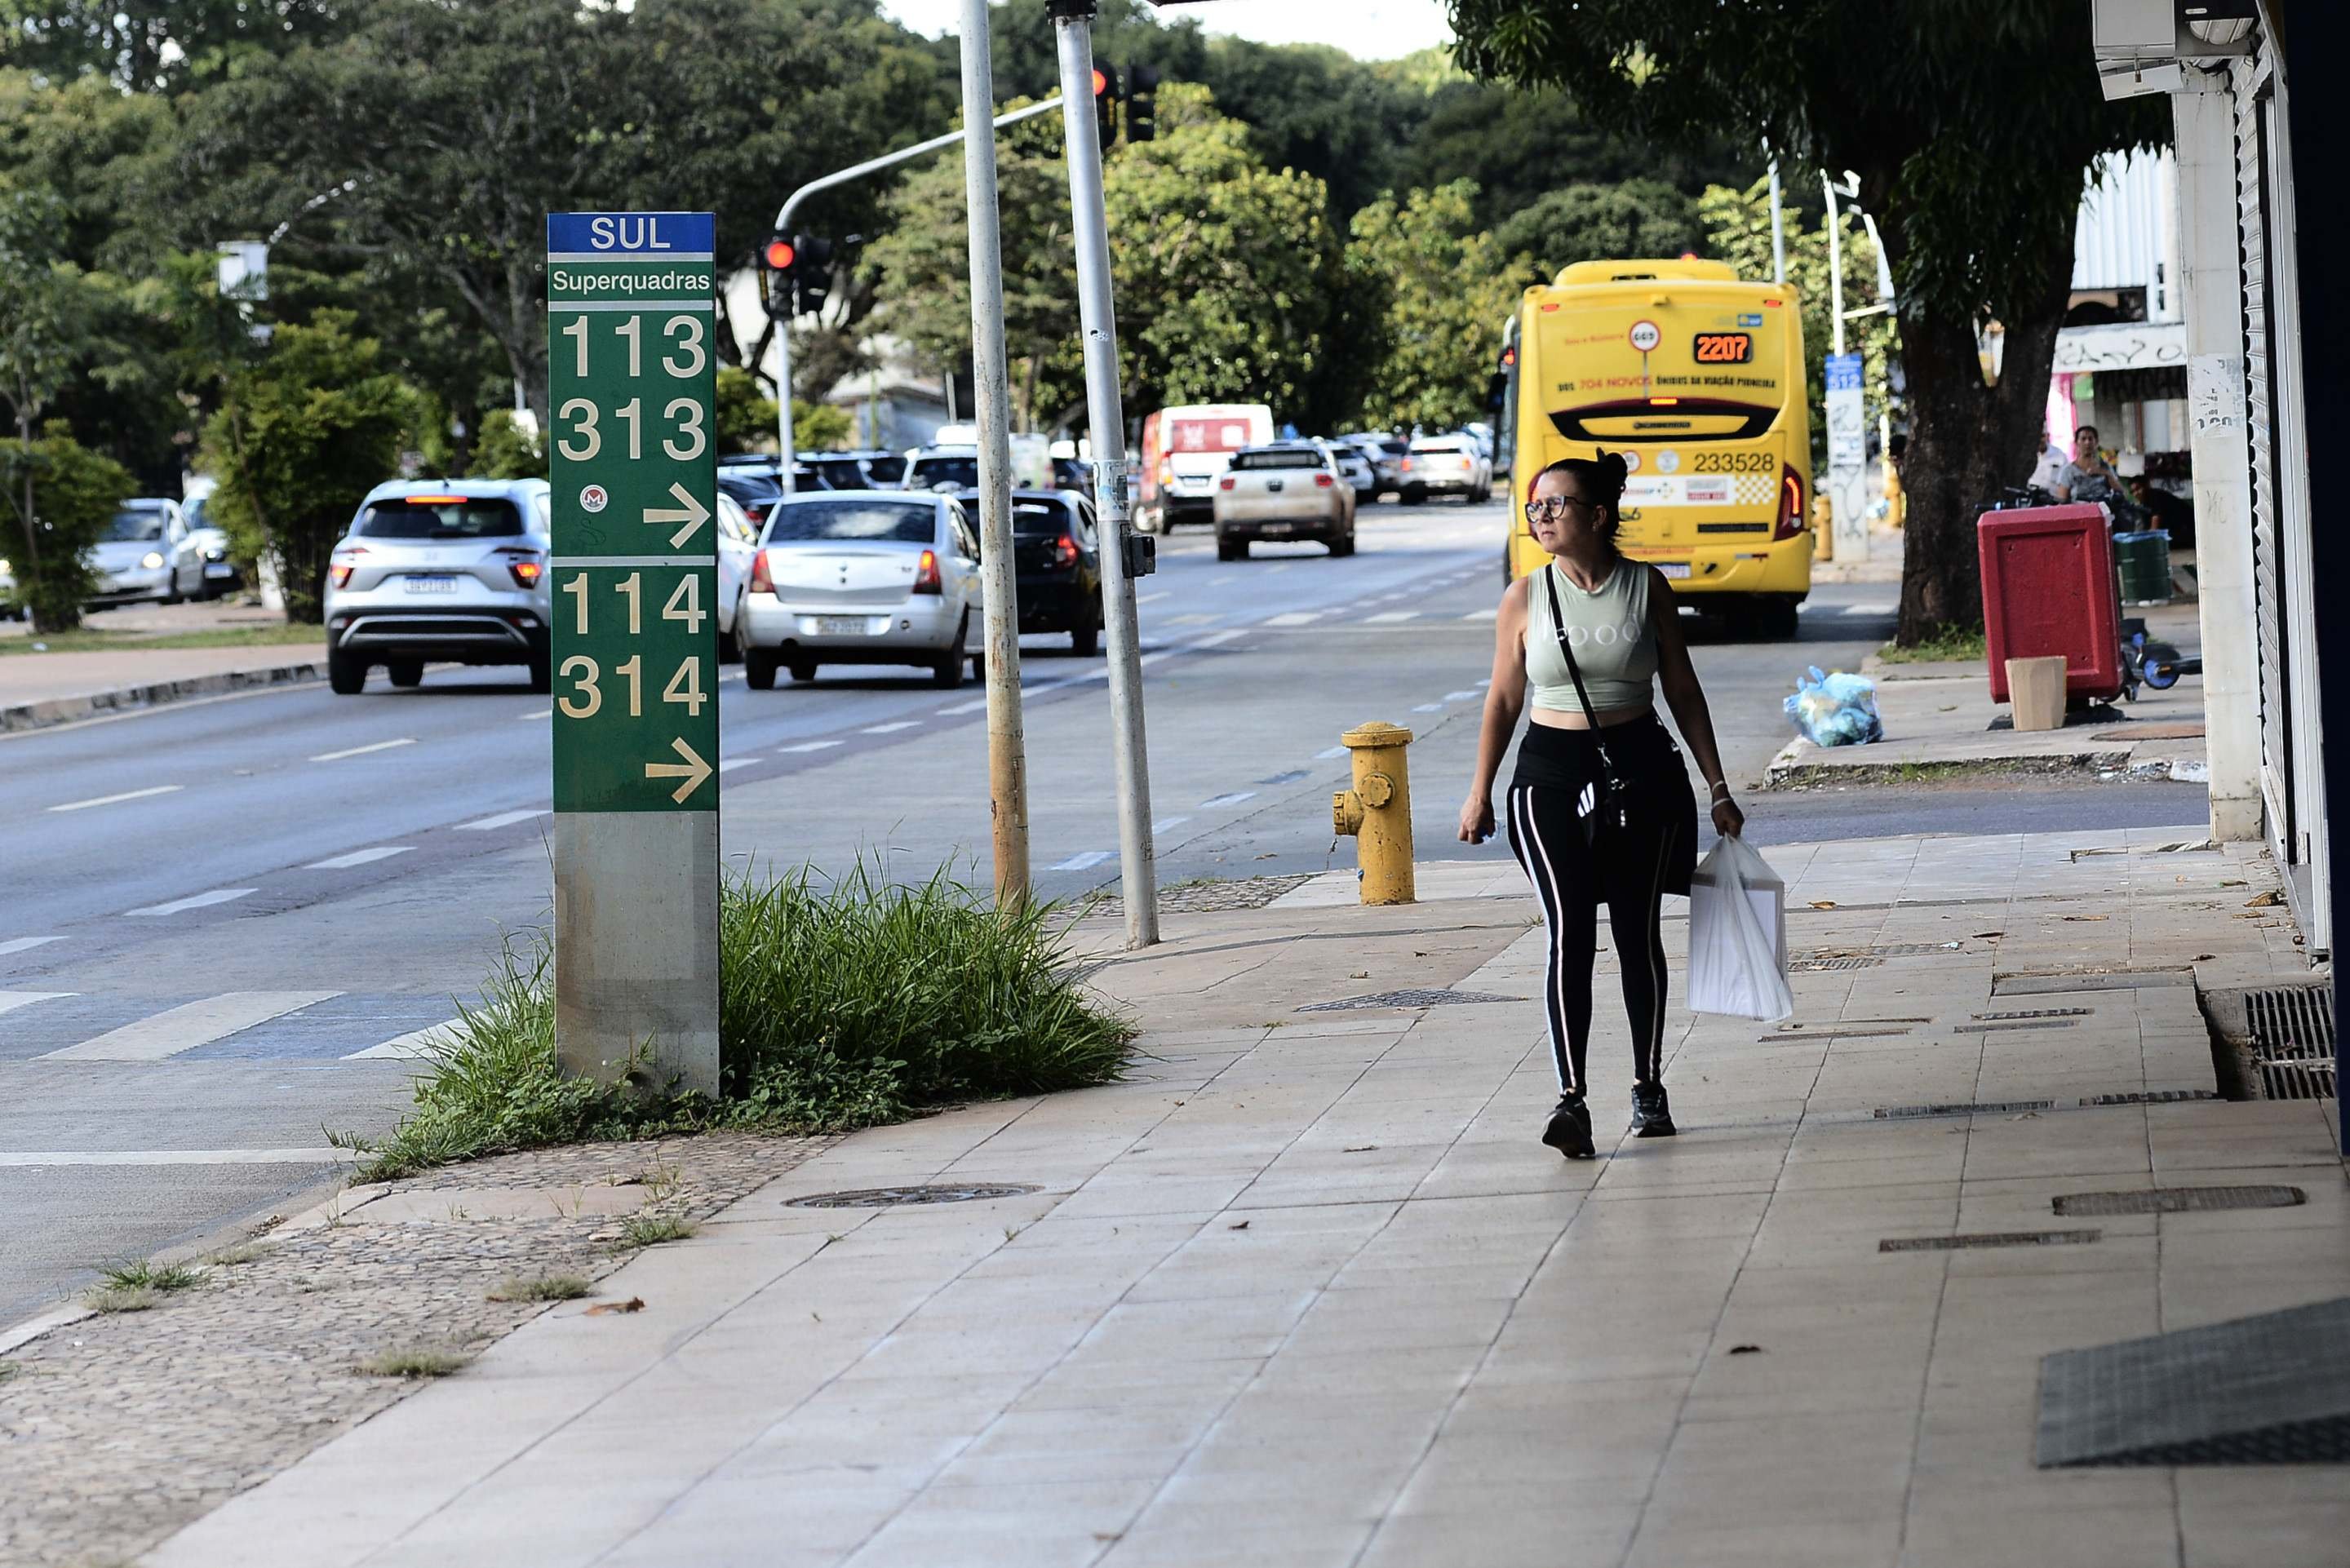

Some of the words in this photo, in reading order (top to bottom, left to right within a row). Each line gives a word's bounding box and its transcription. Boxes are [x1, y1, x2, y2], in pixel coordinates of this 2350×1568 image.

[591, 217, 671, 250] SUL
[552, 270, 711, 295] Superquadras
[562, 315, 706, 379] 113
[1697, 336, 1748, 361] 2207
[558, 397, 707, 461] 313
[1694, 453, 1775, 472] 233528
[563, 572, 707, 635] 114
[558, 654, 707, 719] 314
